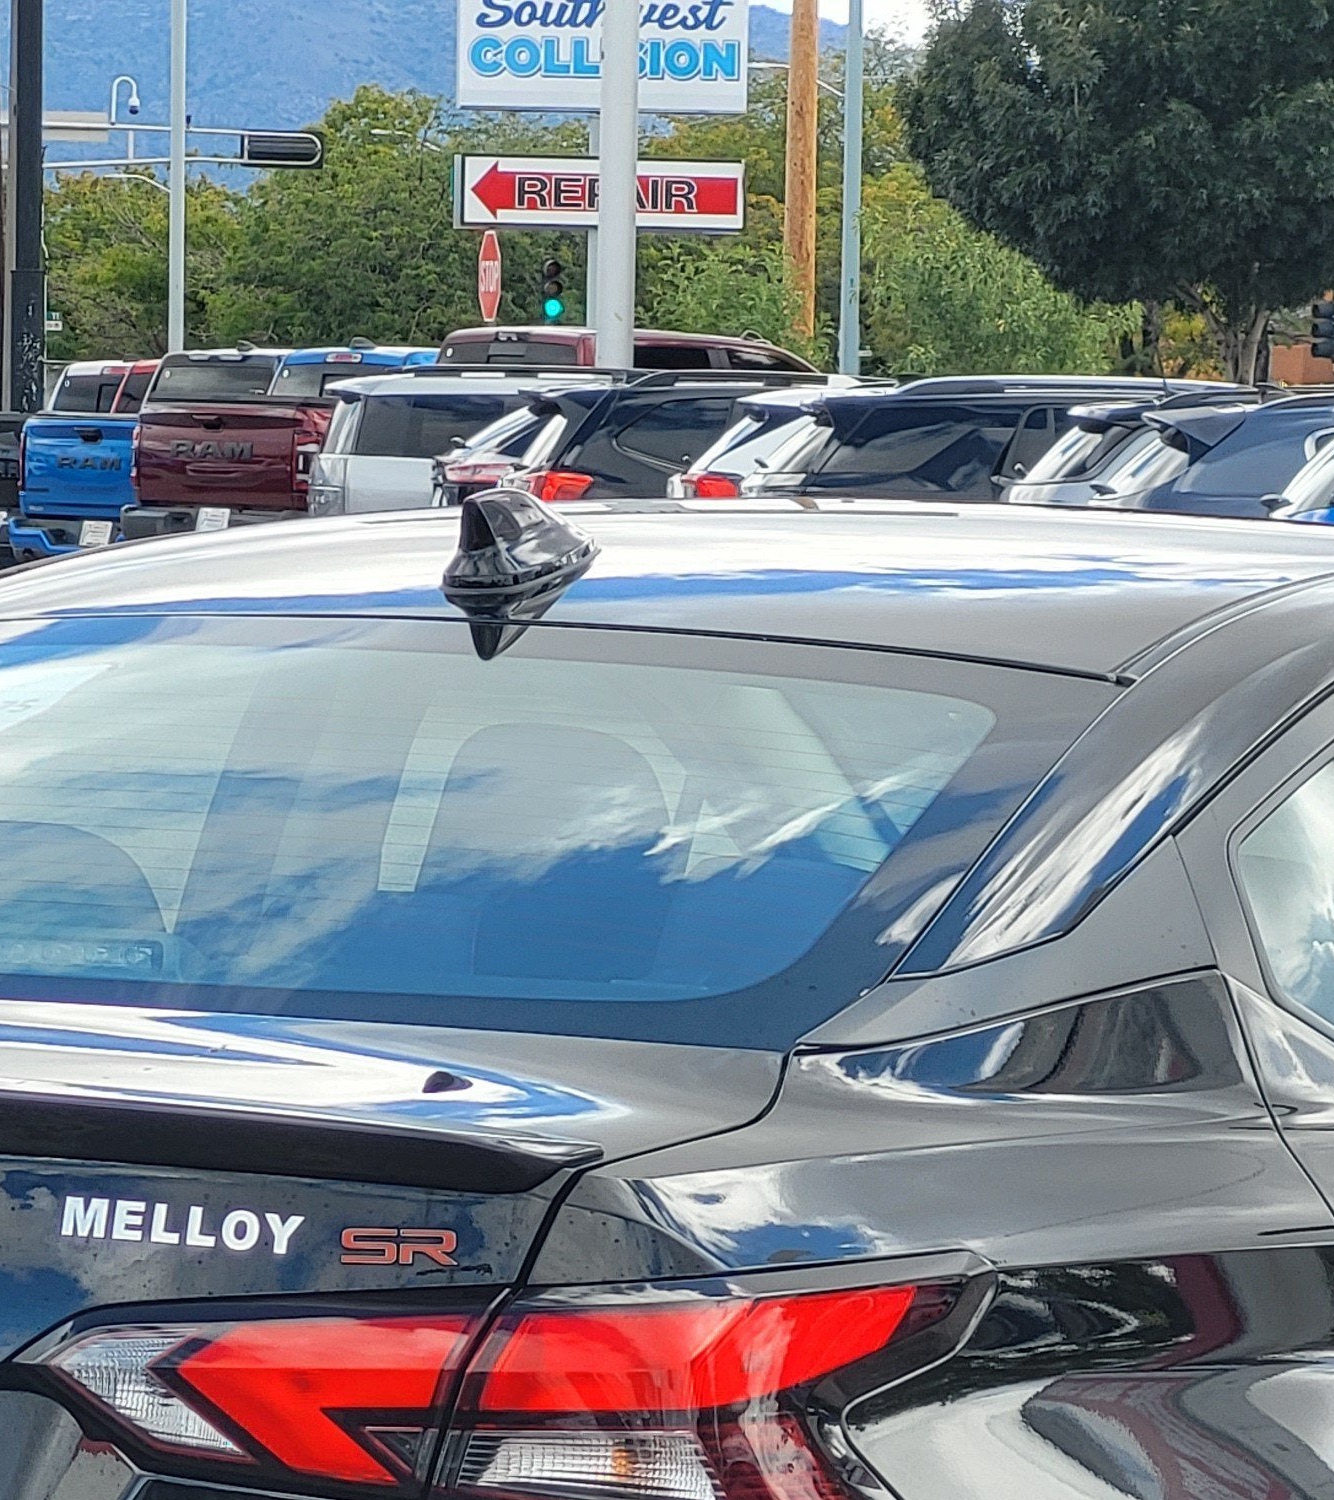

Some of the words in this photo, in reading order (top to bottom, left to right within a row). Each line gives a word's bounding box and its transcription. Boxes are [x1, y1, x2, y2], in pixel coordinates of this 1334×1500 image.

[475, 0, 734, 30] Soutest
[468, 34, 740, 80] COLLION
[481, 260, 499, 293] STOP
[57, 456, 121, 471] RAM
[168, 440, 255, 460] RAM
[60, 1196, 305, 1255] MELLOY
[340, 1227, 459, 1267] SR
